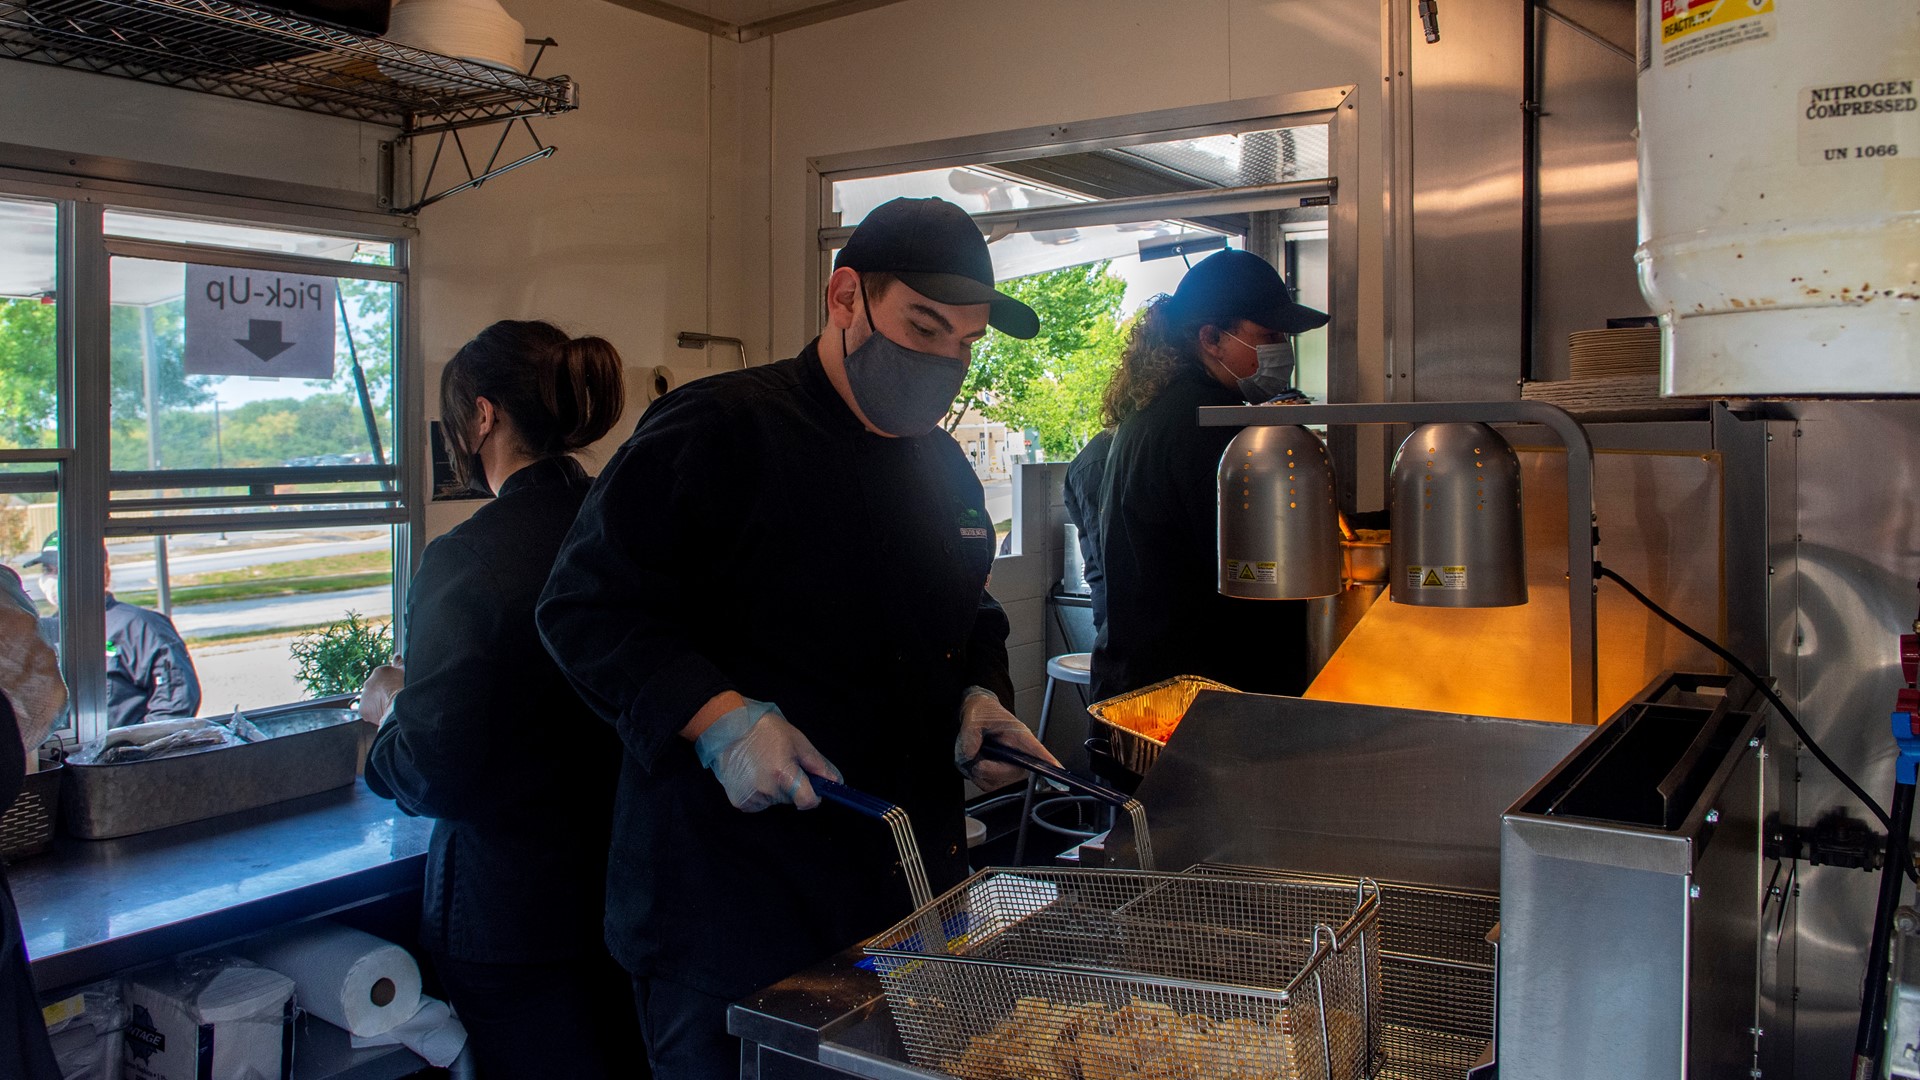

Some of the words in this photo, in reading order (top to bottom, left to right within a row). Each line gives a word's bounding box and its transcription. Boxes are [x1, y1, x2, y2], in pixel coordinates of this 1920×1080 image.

[1811, 81, 1913, 103] NITROGEN
[1806, 98, 1918, 120] COMPRESSED
[1824, 147, 1848, 161] UN
[1855, 145, 1899, 158] 1066
